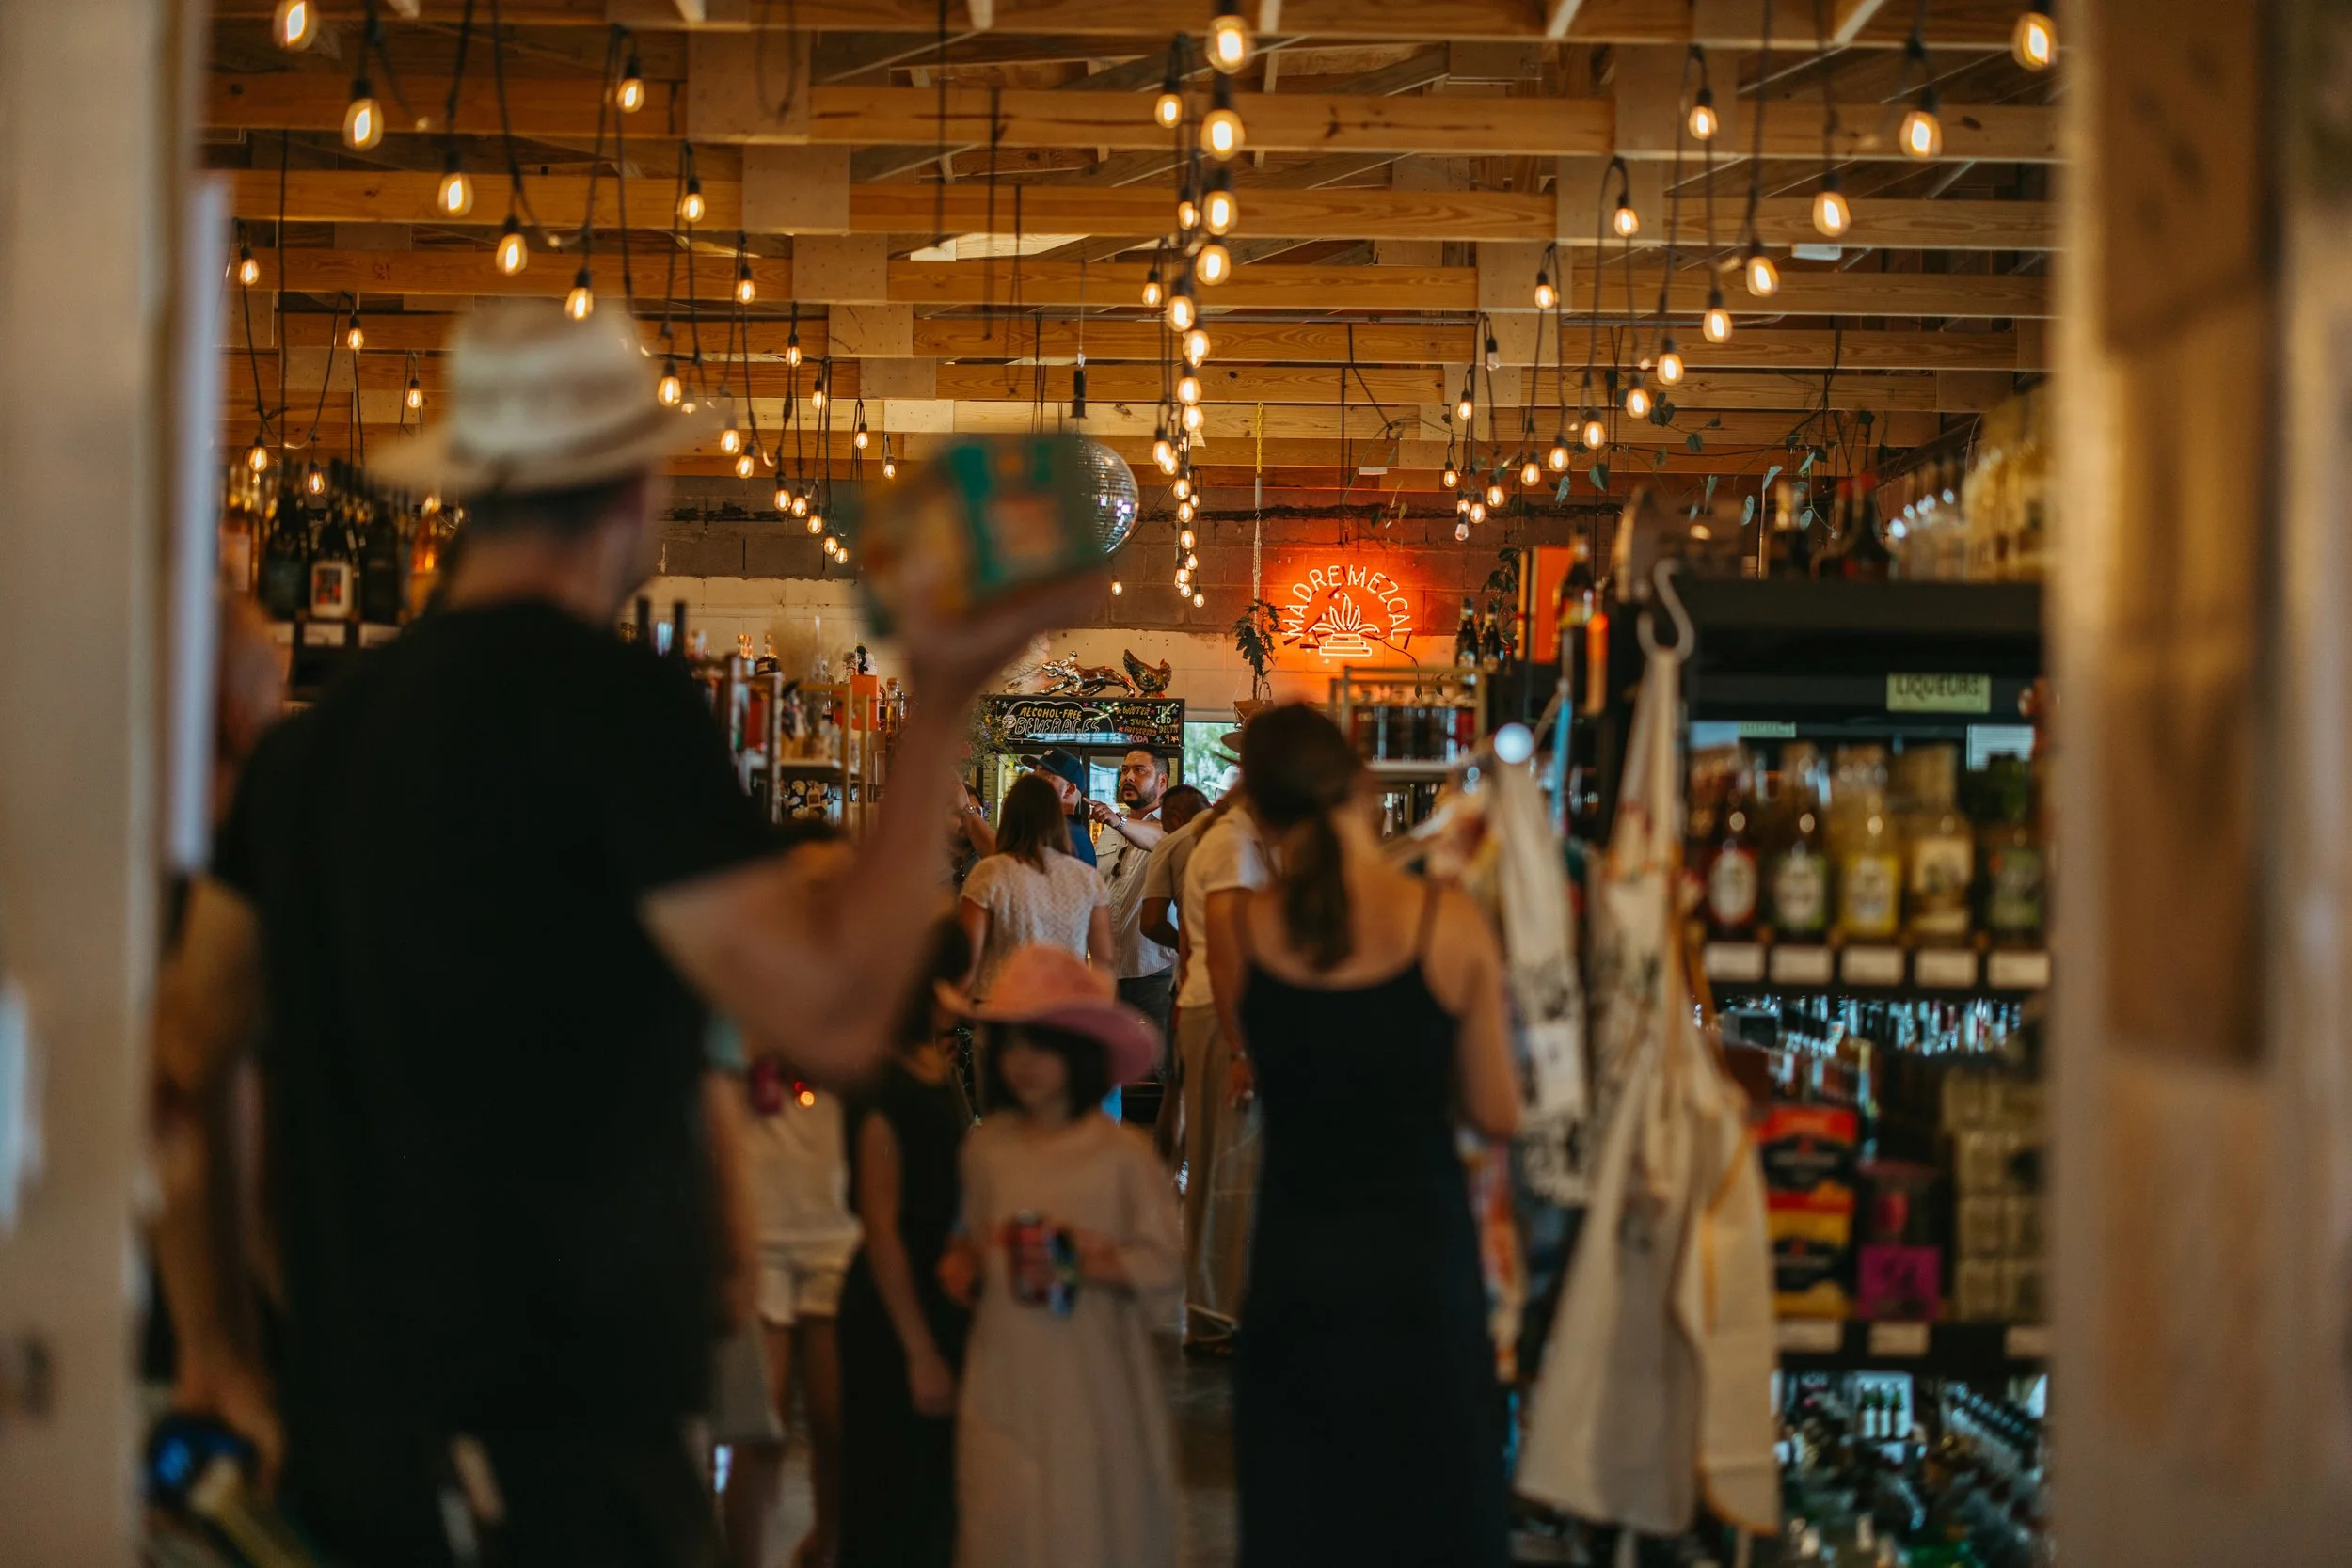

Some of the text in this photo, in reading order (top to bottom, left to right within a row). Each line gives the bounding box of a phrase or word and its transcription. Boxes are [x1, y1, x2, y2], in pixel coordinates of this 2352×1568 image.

[1281, 564, 1412, 640] MADRE MEZCAL
[1895, 674, 1979, 701] LIQUEURS
[1020, 706, 1082, 720] ALCOHOL-FREE
[1122, 705, 1151, 716] WATER
[1015, 716, 1100, 737] BEVERAGES
[1155, 716, 1172, 724] CBD
[1128, 734, 1149, 744] SODA
